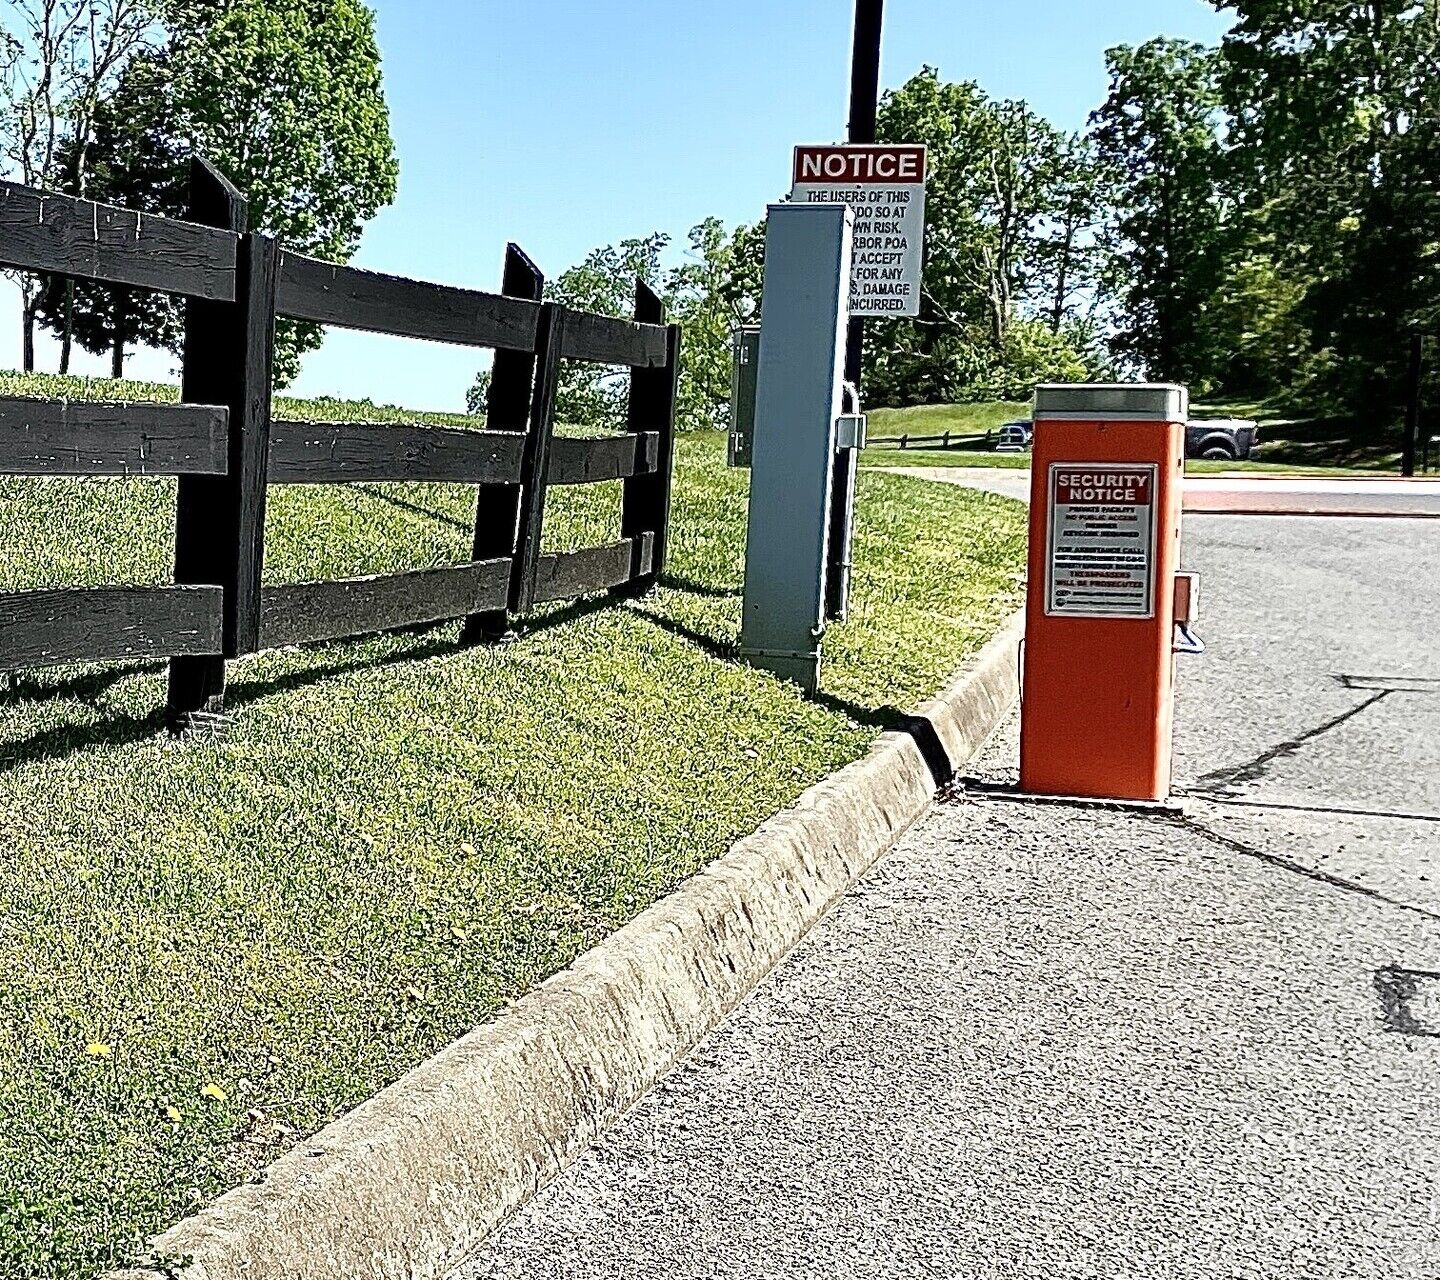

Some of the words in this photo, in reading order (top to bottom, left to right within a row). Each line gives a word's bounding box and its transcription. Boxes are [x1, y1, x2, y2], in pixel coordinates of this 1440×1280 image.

[802, 153, 917, 177] NOTICE
[807, 191, 828, 202] THE
[830, 191, 866, 202] USERS
[869, 191, 883, 202] OF
[886, 191, 910, 203] THIS
[856, 206, 872, 218] DO
[875, 206, 890, 218] SO
[892, 206, 907, 218] AT
[853, 222, 871, 233] WN
[874, 222, 901, 233] RISK.
[852, 237, 882, 249] RBOR
[885, 237, 907, 249] POA
[859, 252, 903, 264] ACCEPT
[857, 268, 878, 279] FOR
[880, 268, 903, 279] ANY
[863, 283, 910, 295] DAMAGE
[1058, 475, 1148, 487] SECURITY
[1069, 488, 1136, 500] NOTICE
